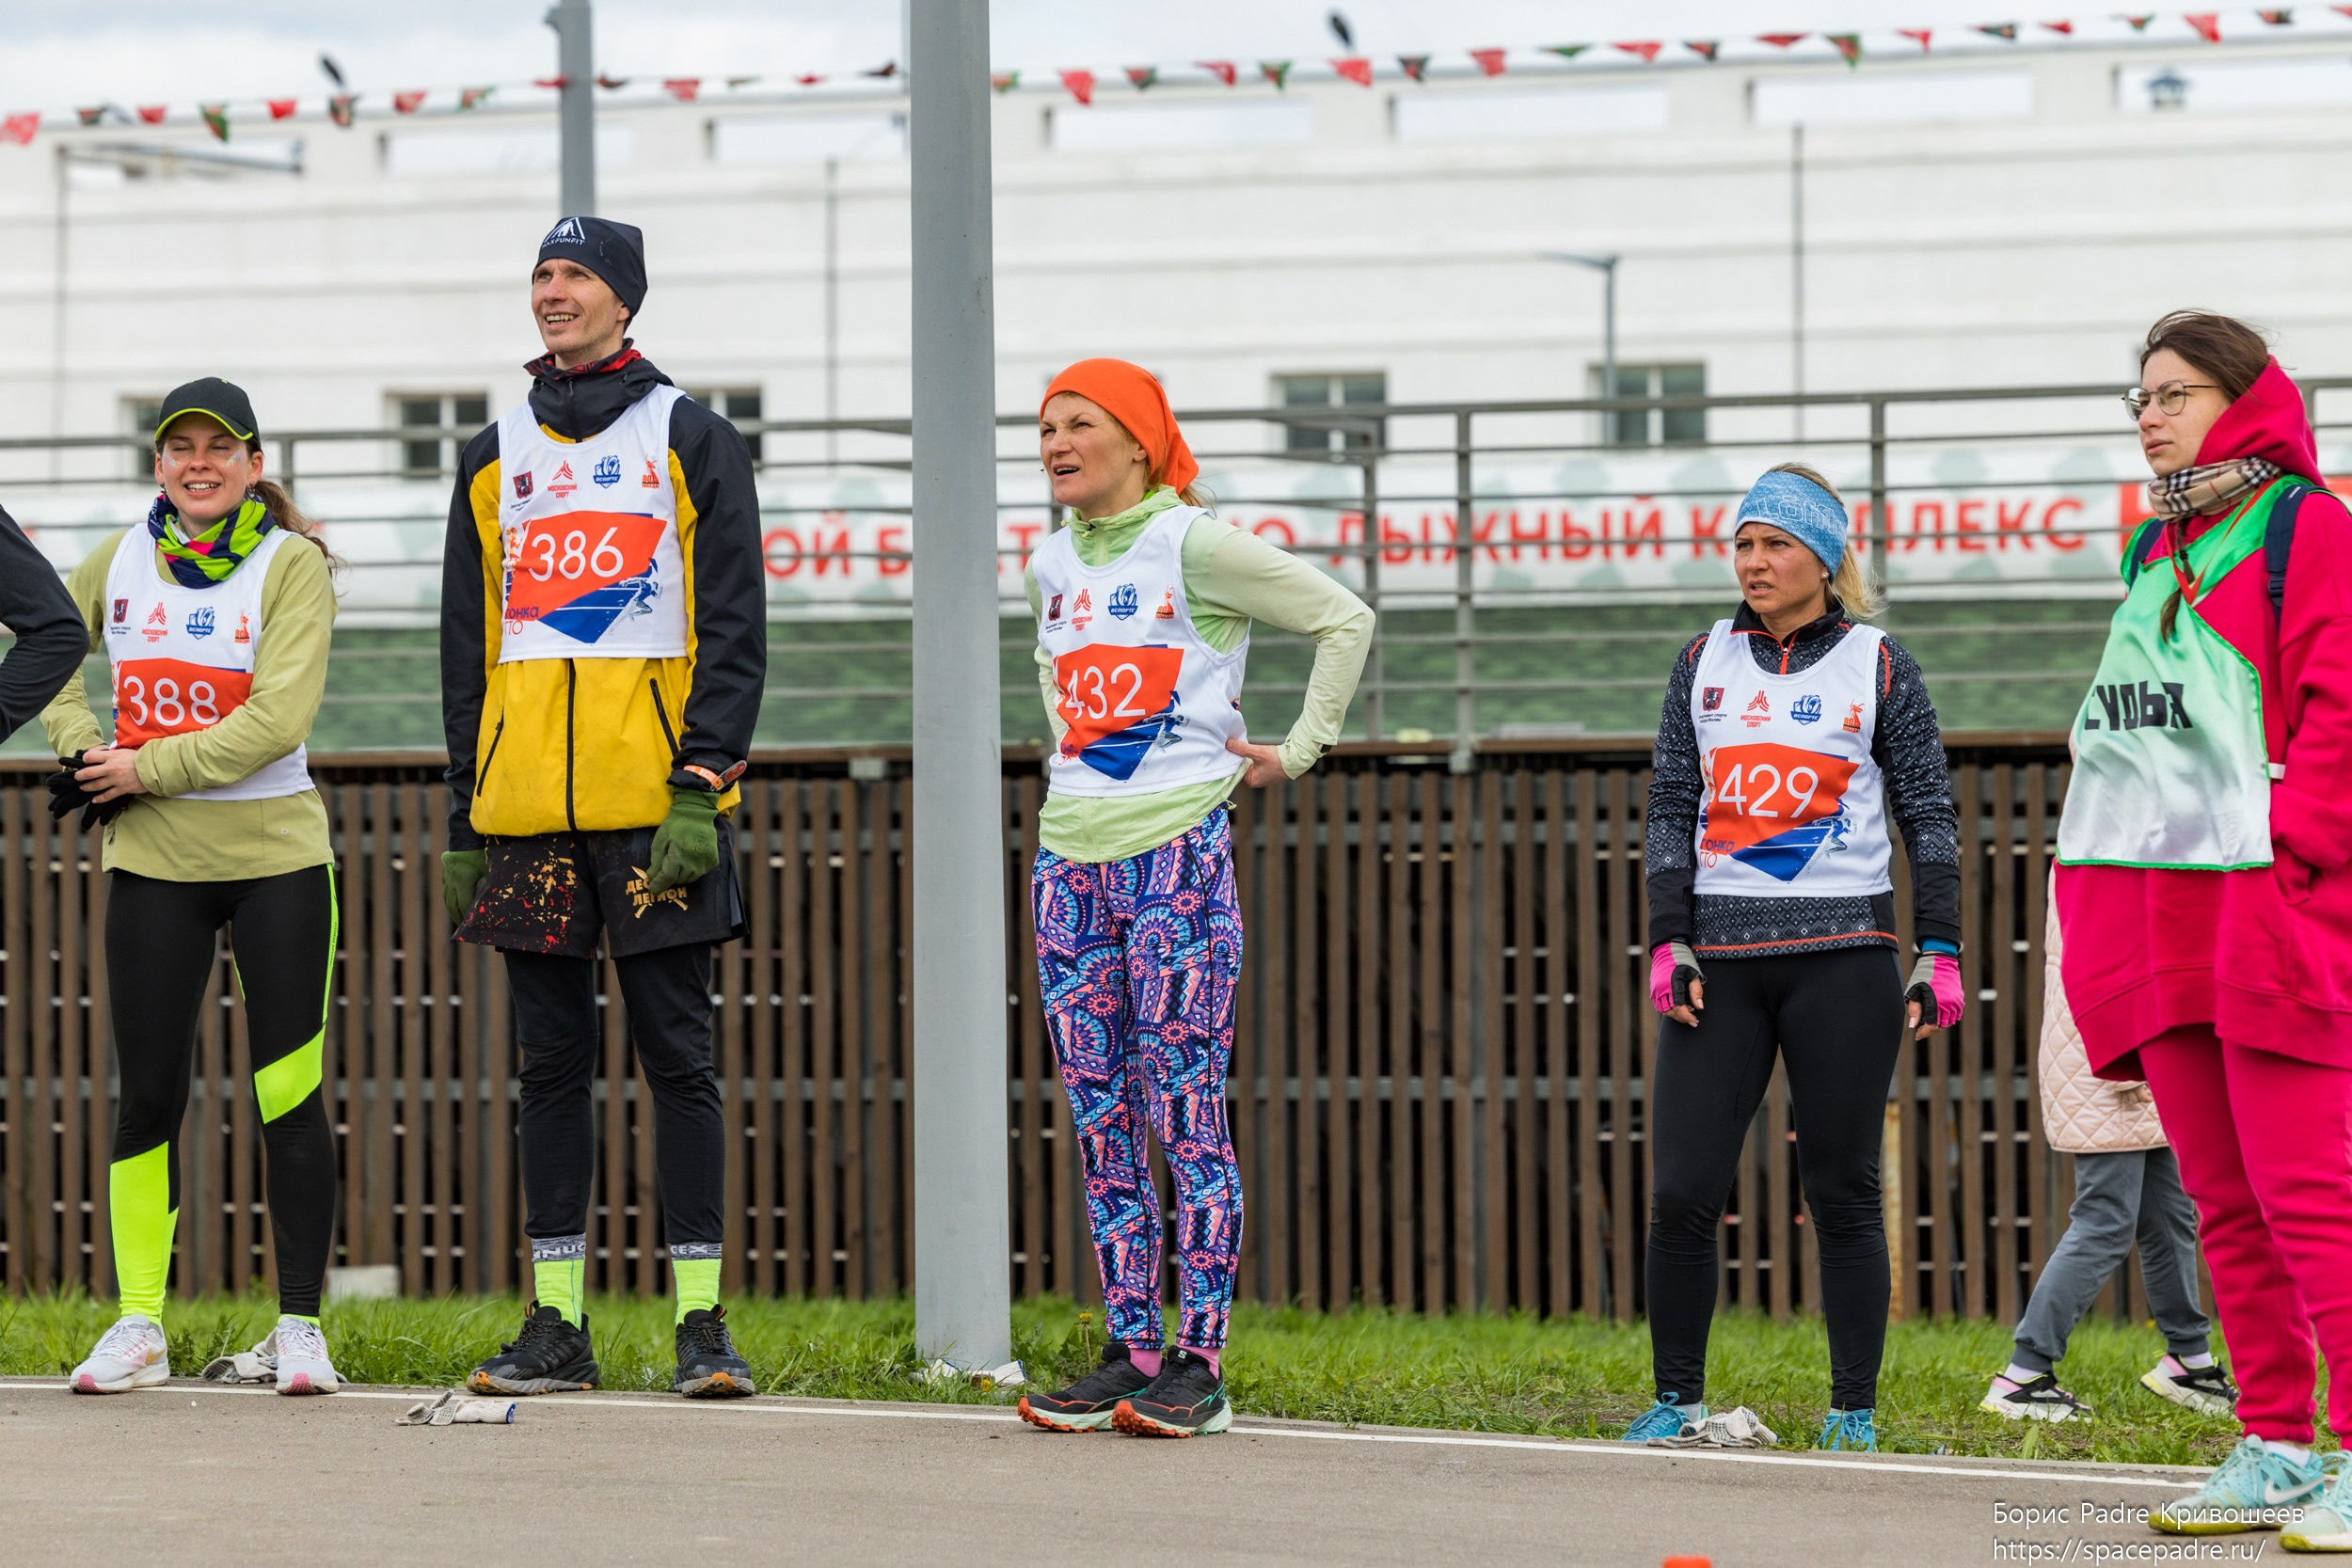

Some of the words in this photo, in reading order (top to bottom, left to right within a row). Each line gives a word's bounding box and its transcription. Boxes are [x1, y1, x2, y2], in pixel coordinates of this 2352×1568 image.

[529, 527, 624, 581] 386
[123, 675, 220, 727] 388
[1066, 663, 1146, 720] 432
[1718, 763, 1819, 818] 429
